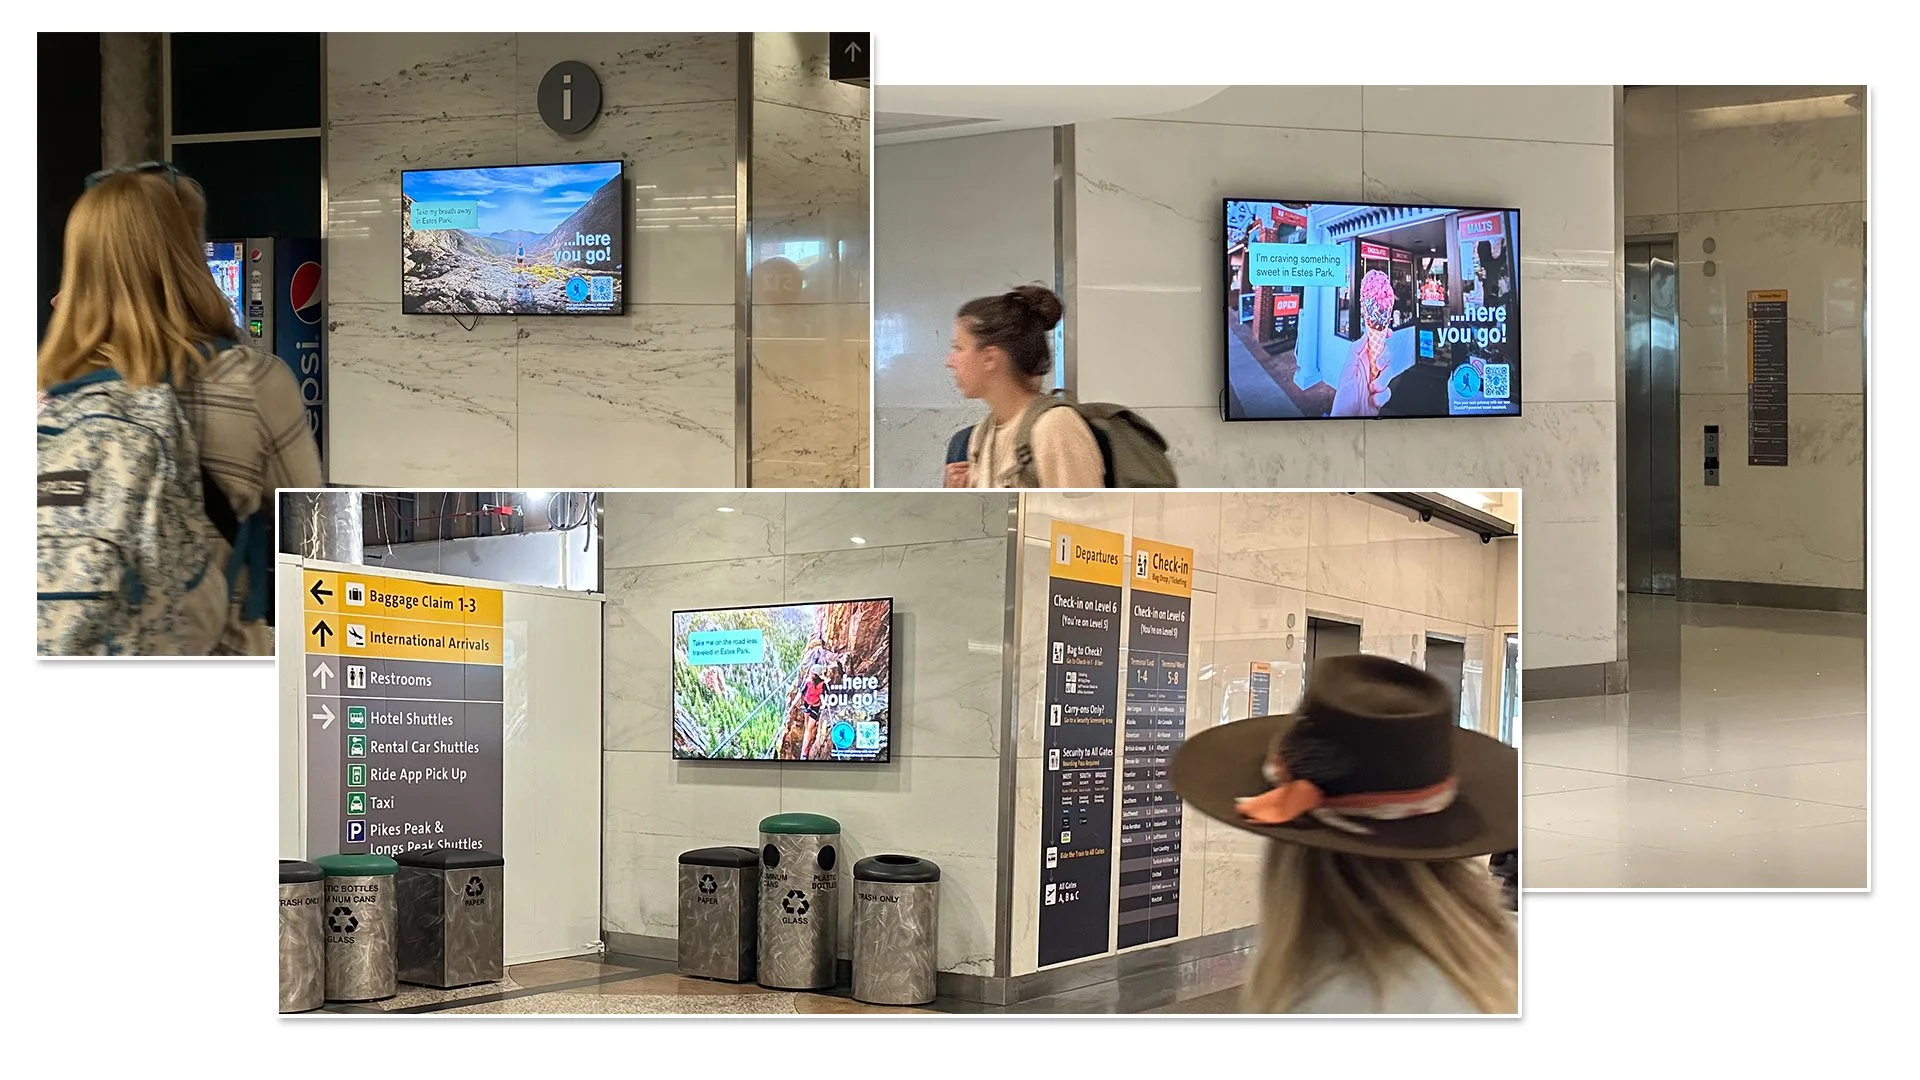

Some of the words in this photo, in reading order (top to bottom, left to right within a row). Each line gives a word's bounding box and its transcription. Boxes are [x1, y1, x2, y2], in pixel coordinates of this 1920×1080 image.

[1467, 220, 1493, 234] MALTS
[564, 232, 611, 246] ...here
[554, 250, 580, 264] you
[586, 248, 611, 264] go!
[1256, 254, 1268, 263] I'm
[1270, 254, 1298, 265] craving
[1300, 254, 1340, 266] something
[1256, 268, 1280, 277] sweet
[1282, 268, 1289, 276] in
[1292, 267, 1313, 277] Estes
[1316, 268, 1334, 277] Park.
[1277, 300, 1297, 310] OPEN
[1450, 302, 1506, 322] ...here
[1437, 327, 1471, 347] you
[1477, 324, 1506, 347] go!
[1076, 545, 1118, 566] Departures
[1152, 553, 1188, 575] Check-in
[1160, 575, 1168, 584] Drop
[1172, 577, 1187, 588] Ticketing
[370, 590, 418, 610] Baggage
[422, 596, 454, 610] Claim
[458, 598, 476, 612] 1-3
[1054, 594, 1084, 607] Check-in
[1085, 600, 1093, 608] on
[1095, 599, 1112, 613] Level
[1112, 602, 1117, 614] 6
[1134, 605, 1158, 619] Check-in
[1159, 611, 1166, 620] on
[1167, 610, 1180, 621] Level
[1181, 612, 1185, 622] 6
[1062, 615, 1080, 627] (You're
[1082, 618, 1088, 626] on
[1090, 618, 1103, 628] Level
[1104, 619, 1108, 631] 5)
[1141, 624, 1155, 635] (You're
[1162, 627, 1173, 636] Level
[370, 631, 444, 648] International
[448, 637, 490, 651] Arrivals
[1067, 645, 1077, 657] Bag
[1078, 646, 1084, 655] to
[1085, 646, 1102, 656] Check?
[370, 672, 432, 686] Restrooms
[831, 674, 878, 690] ...here
[1137, 670, 1148, 683] 1-4
[1168, 671, 1179, 685] 5-8
[820, 692, 848, 709] you
[852, 691, 878, 709] go!
[1064, 704, 1089, 716] Carry-ons
[1090, 705, 1105, 716] Only?
[370, 712, 402, 725] Hotel
[406, 712, 453, 726] Shuttles
[370, 741, 407, 753] Rental
[411, 741, 429, 753] Car
[434, 741, 479, 753] Shuttles
[1062, 748, 1084, 759] Security
[1085, 748, 1090, 756] to
[1099, 747, 1113, 756] Gates
[370, 768, 396, 781] Ride
[400, 768, 422, 784] App
[426, 767, 448, 780] Pick
[452, 768, 466, 783] Up
[370, 796, 394, 809] Taxi
[370, 824, 400, 836] Pikes
[404, 821, 431, 835] Peak
[435, 820, 444, 833] &
[370, 843, 403, 857] Longs
[279, 898, 303, 906] RASH
[464, 898, 485, 907] PAPER
[698, 897, 718, 905] PAPER
[1059, 894, 1064, 904] A,
[1065, 893, 1069, 901] B
[1075, 891, 1080, 900] C
[782, 916, 808, 924] GLASS
[327, 936, 355, 944] GLASS
